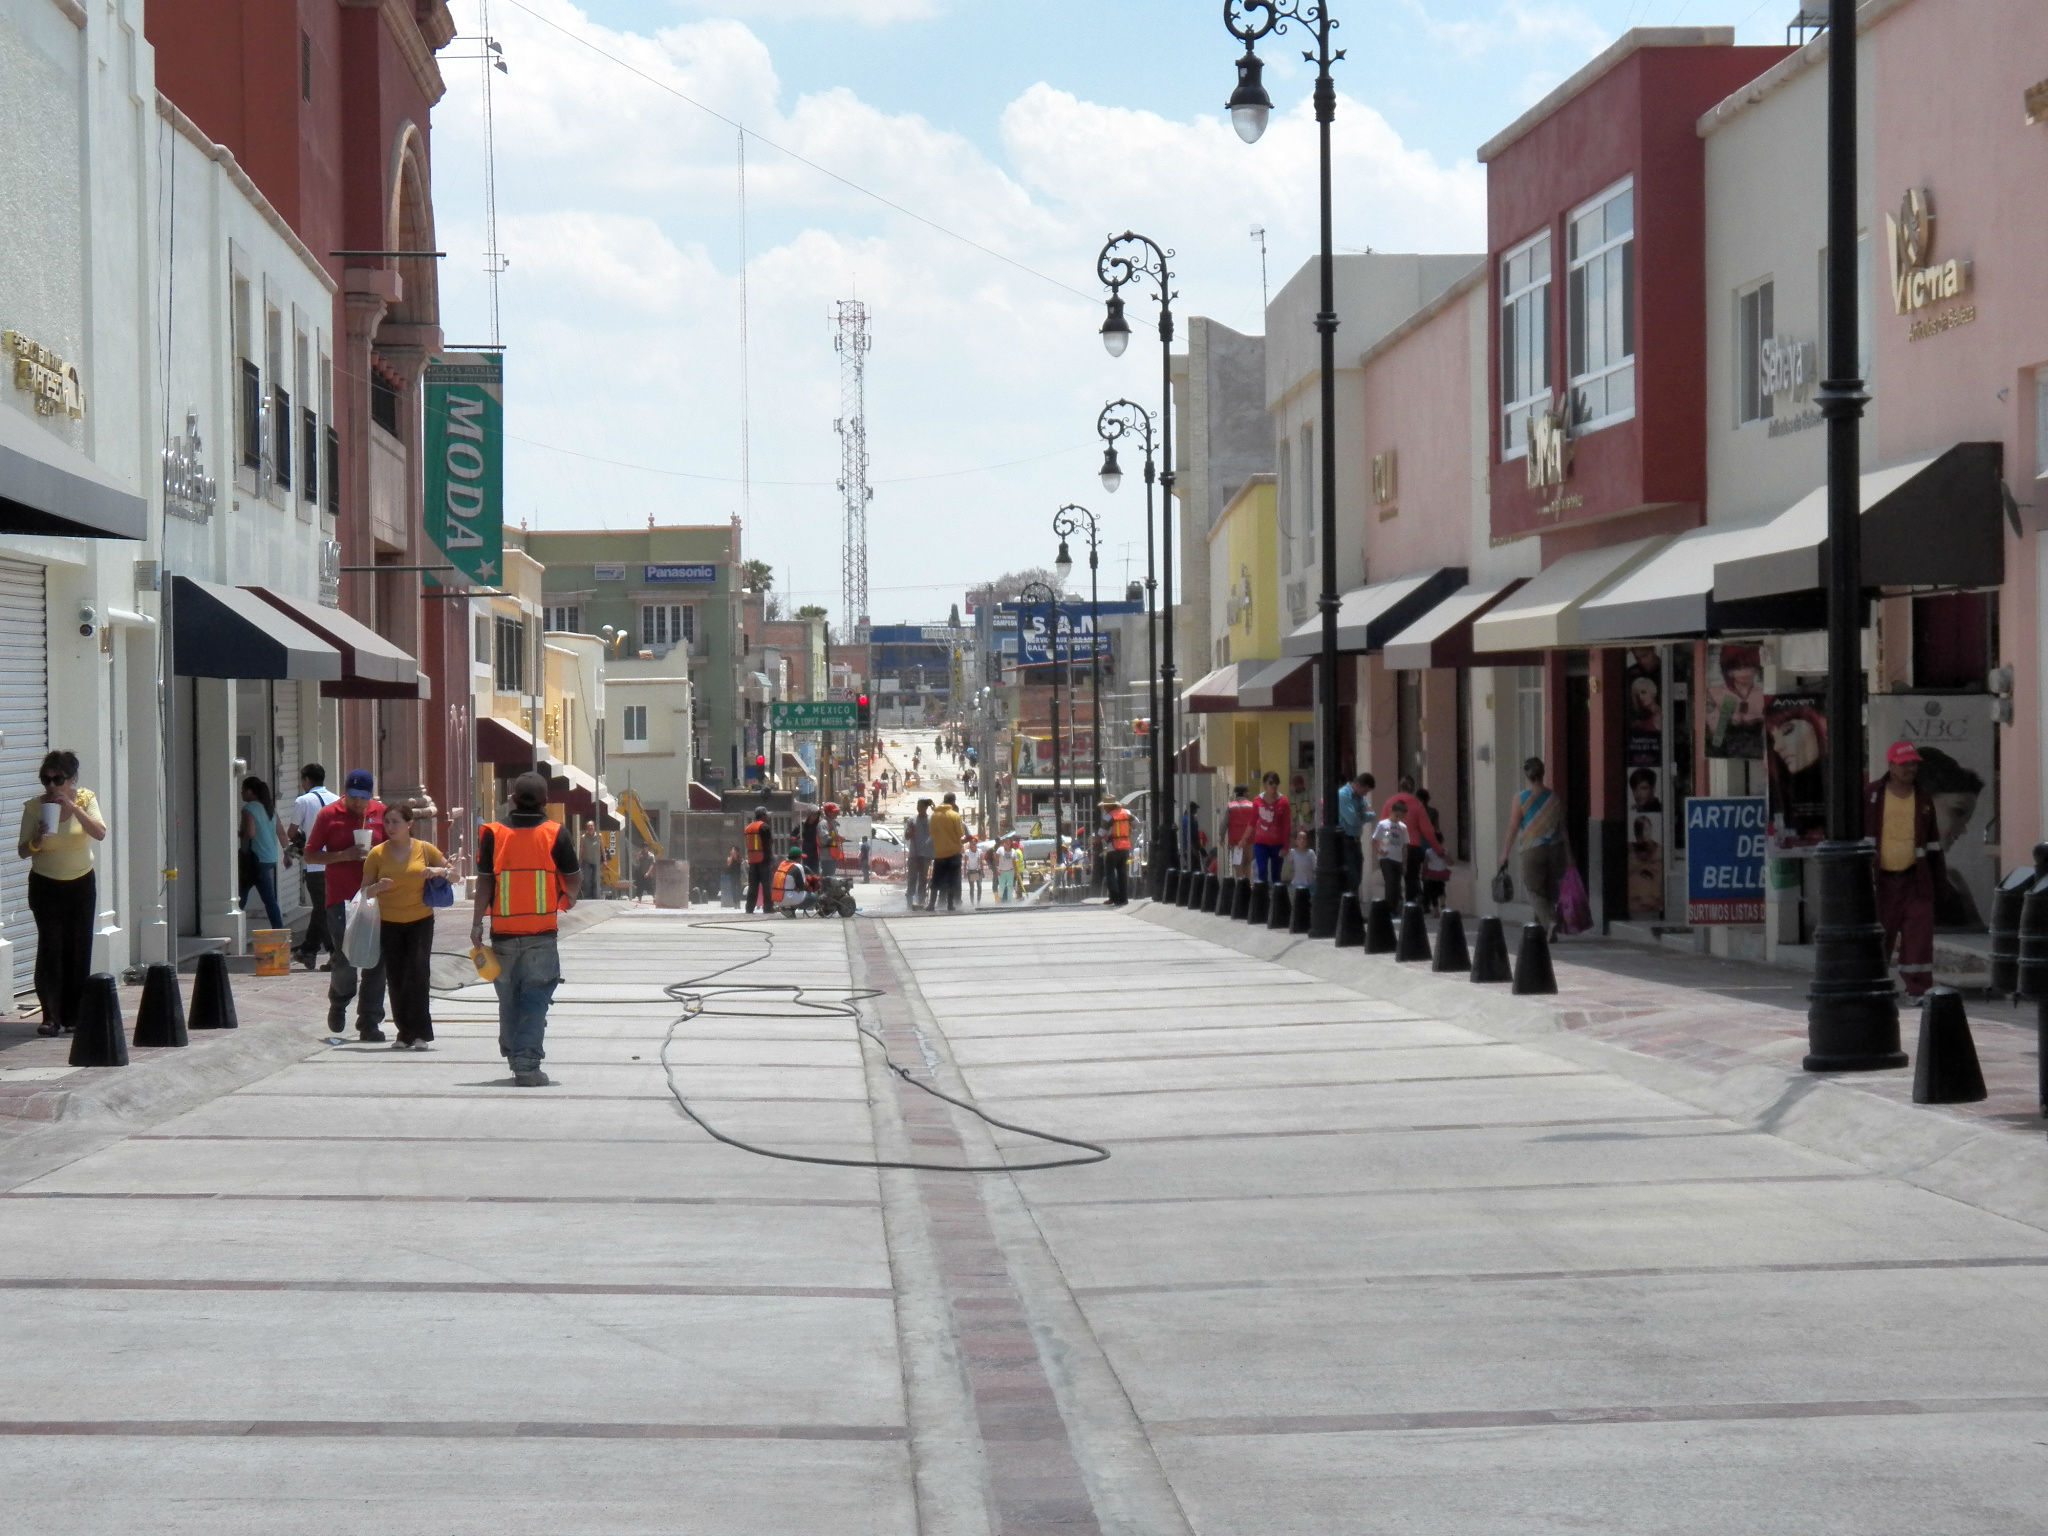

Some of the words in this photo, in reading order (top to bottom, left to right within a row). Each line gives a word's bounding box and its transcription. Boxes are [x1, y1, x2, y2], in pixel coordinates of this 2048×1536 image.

[446, 392, 483, 550] MODA
[647, 566, 713, 577] Panasonic
[812, 705, 850, 714] MEXICO
[1688, 904, 1729, 921] SURTIMOS
[1730, 904, 1759, 921] LISTAS
